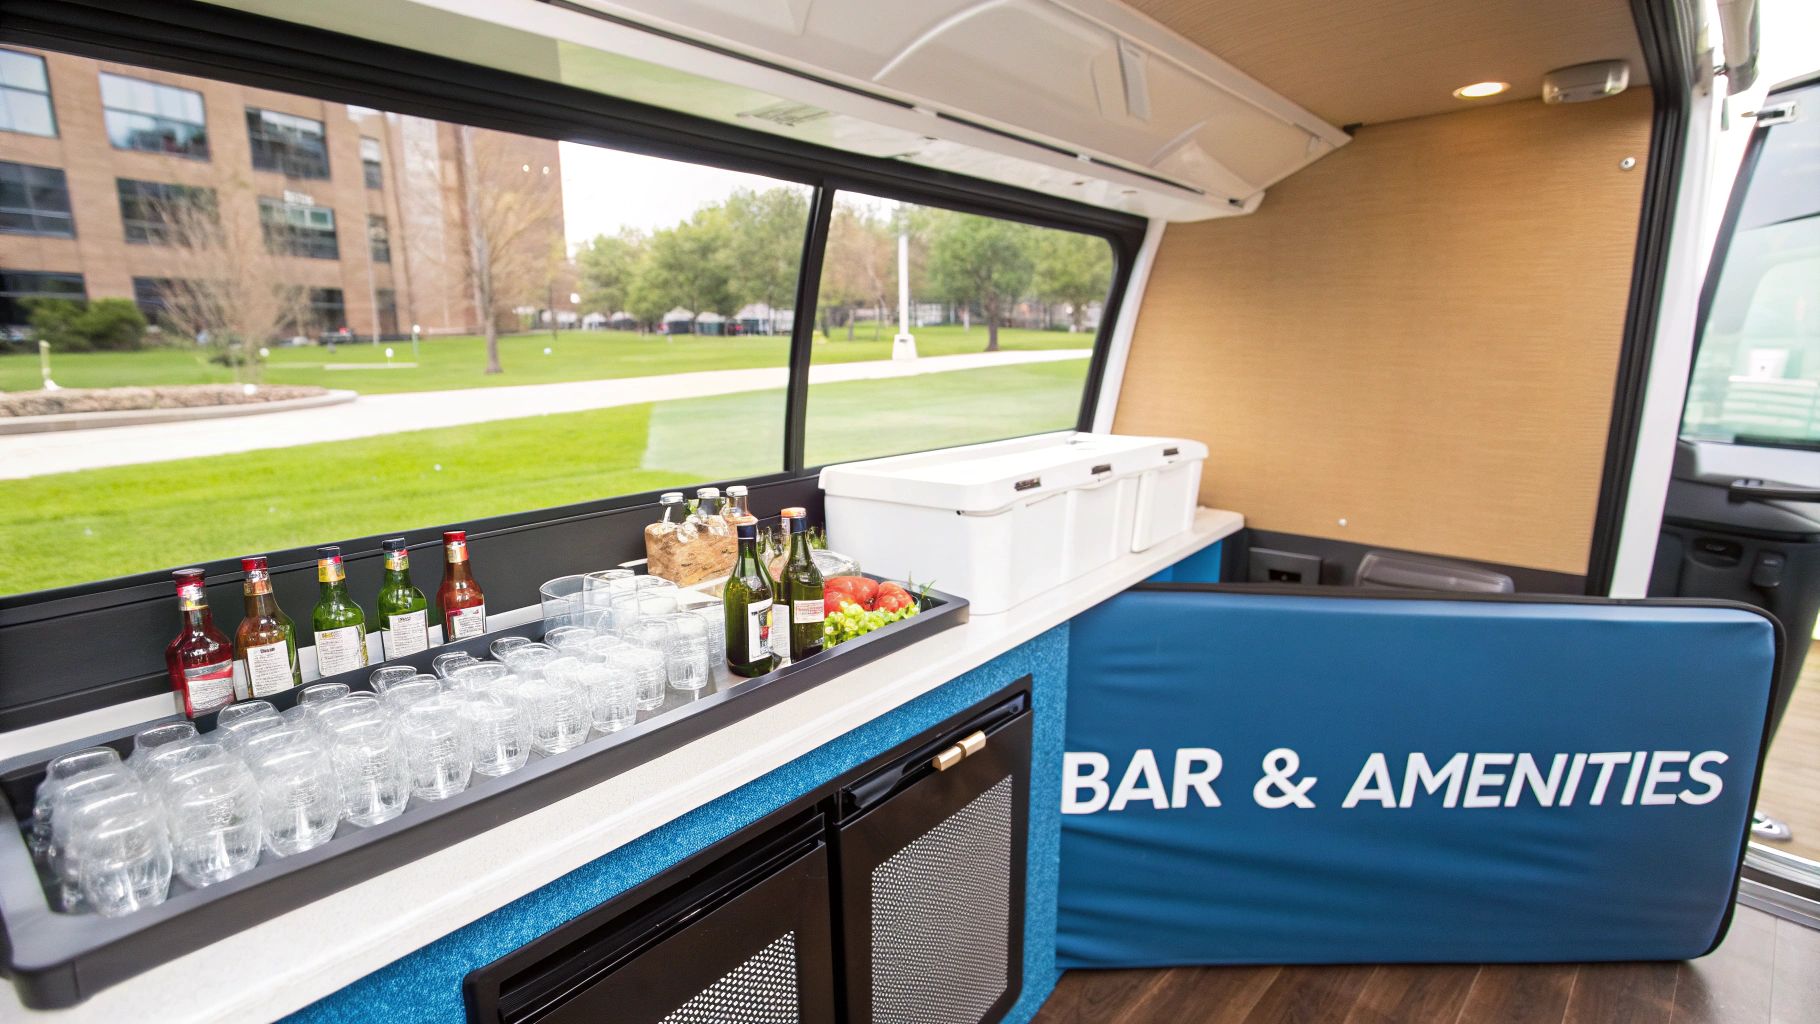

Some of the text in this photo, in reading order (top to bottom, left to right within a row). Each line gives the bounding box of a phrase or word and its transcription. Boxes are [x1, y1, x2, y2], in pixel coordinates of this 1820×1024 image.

[1060, 747, 1729, 815] BAR & AMENITIES
